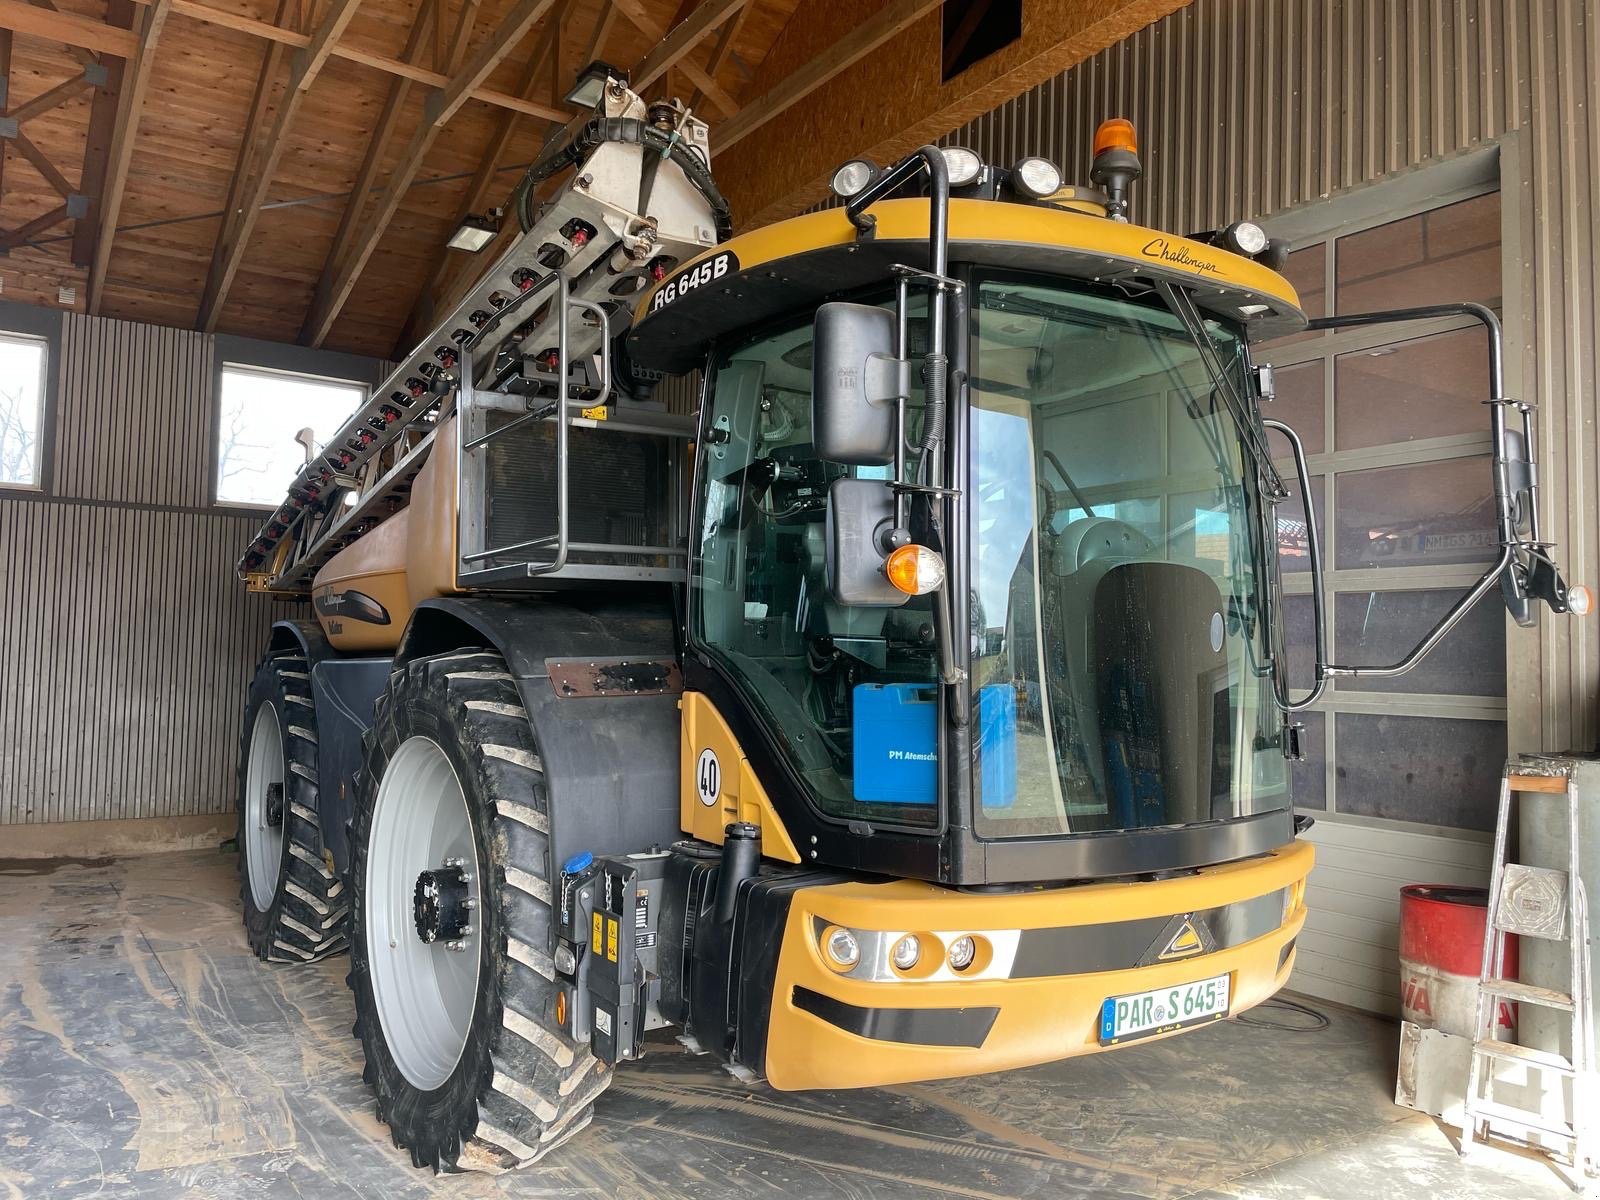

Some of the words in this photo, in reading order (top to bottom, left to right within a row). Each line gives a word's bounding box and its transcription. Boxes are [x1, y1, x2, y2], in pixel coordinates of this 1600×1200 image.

[1141, 238, 1229, 275] Challenger
[653, 282, 676, 311] RG
[889, 750, 903, 760] PM
[700, 757, 717, 797] 40
[1105, 1022, 1112, 1032] D
[1116, 996, 1154, 1031] PAR
[1167, 990, 1180, 1020] S
[1183, 982, 1216, 1016] 645
